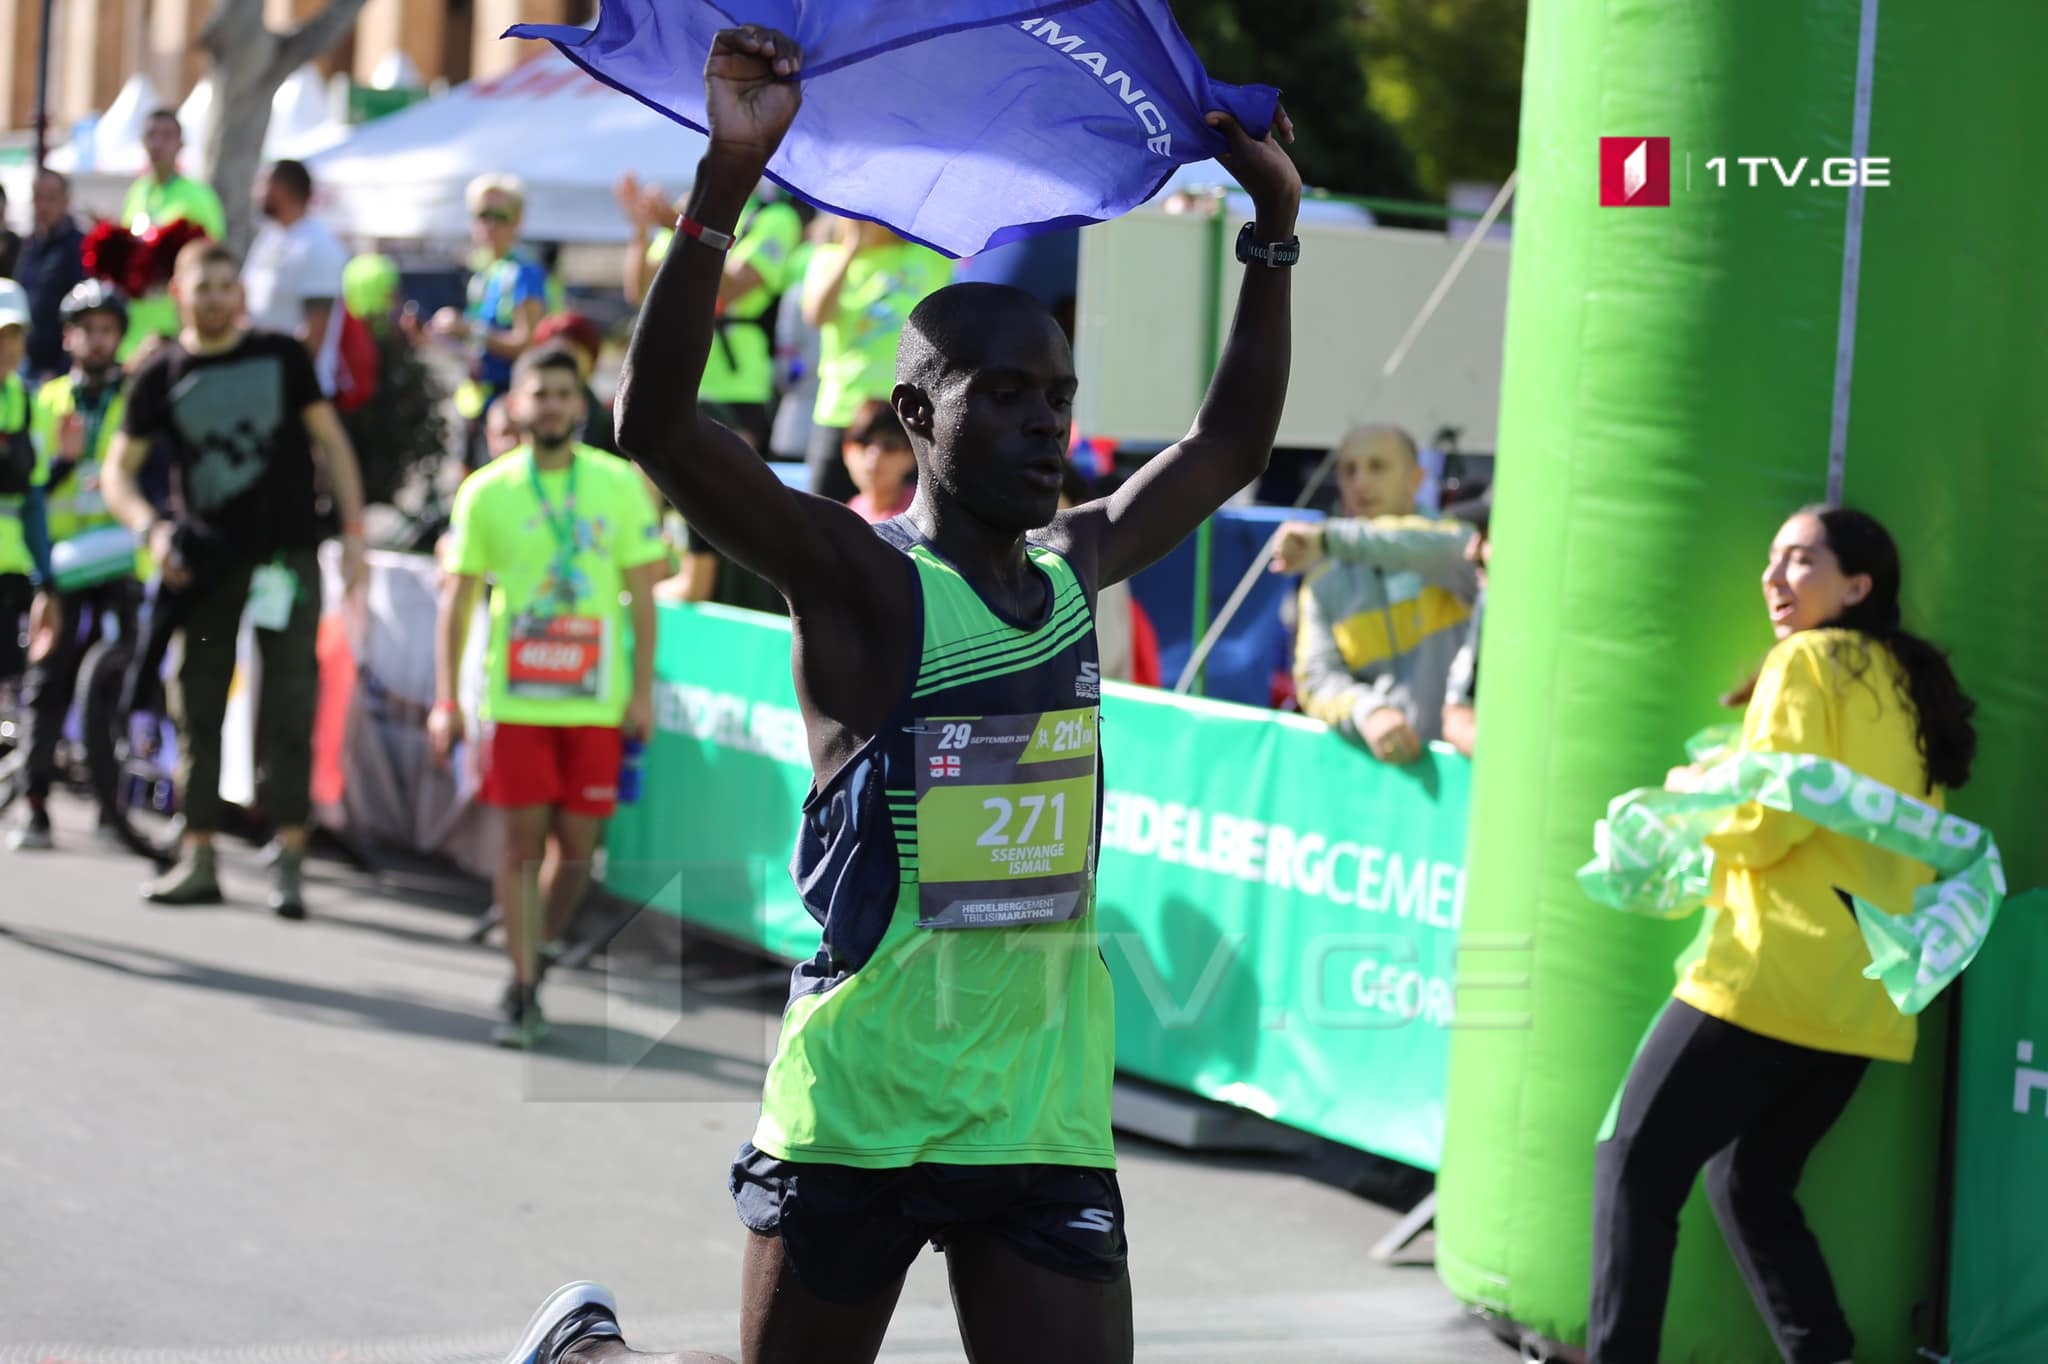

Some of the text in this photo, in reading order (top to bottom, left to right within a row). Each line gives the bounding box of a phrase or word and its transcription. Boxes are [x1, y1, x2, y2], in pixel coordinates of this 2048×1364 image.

[938, 723, 972, 750] 29
[970, 734, 1015, 745] SEPTEMBER
[976, 792, 1065, 846] 271
[991, 843, 1065, 863] SSENYANGE
[1008, 858, 1053, 875] ISMAIL
[961, 899, 1054, 914] HEIDELBERGCEMENT
[962, 908, 1054, 924] TBILISIMARATHON
